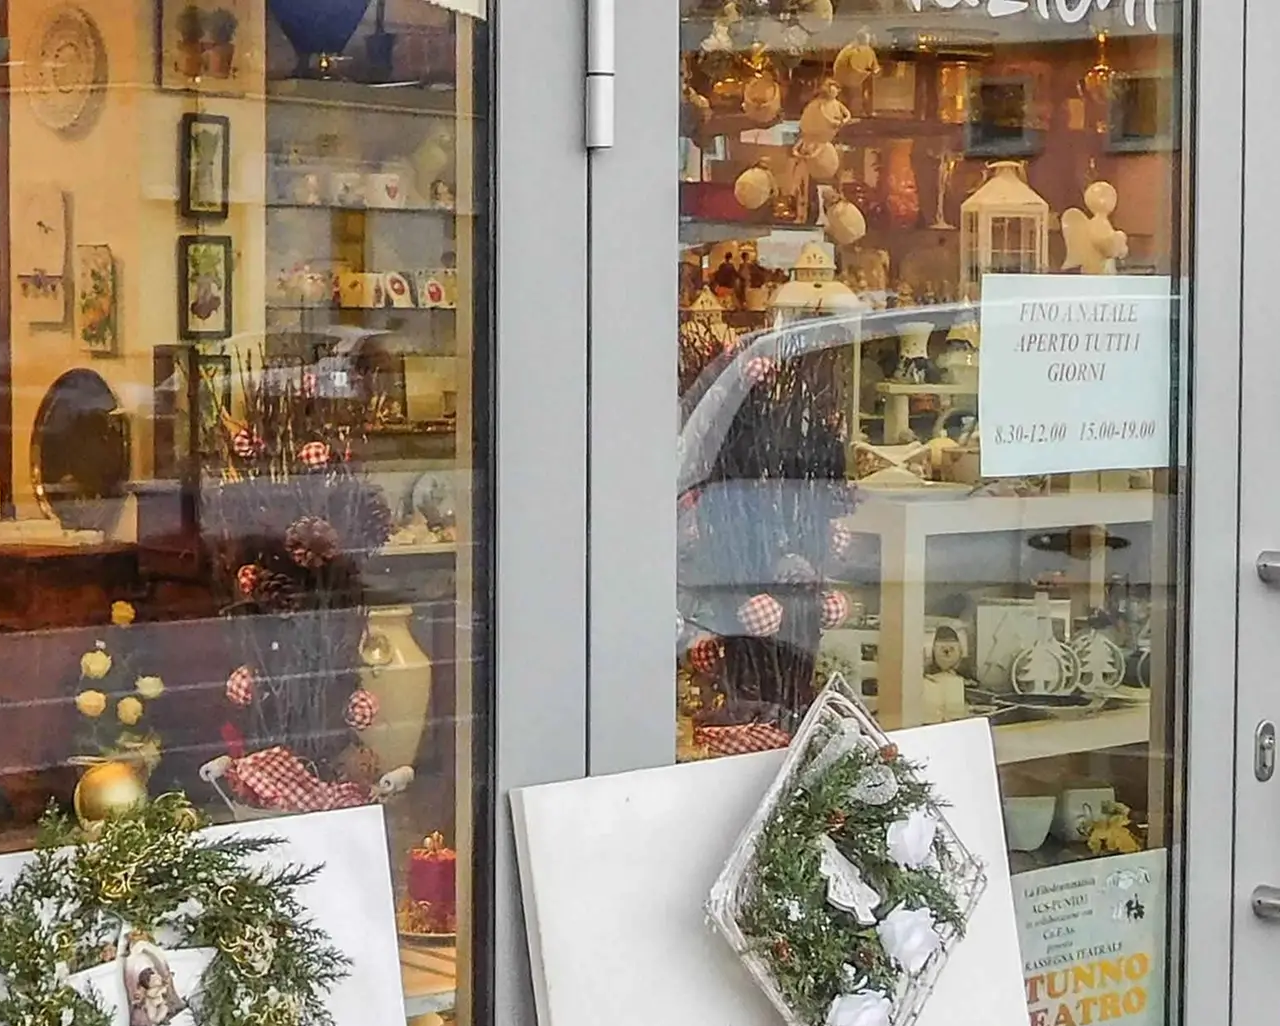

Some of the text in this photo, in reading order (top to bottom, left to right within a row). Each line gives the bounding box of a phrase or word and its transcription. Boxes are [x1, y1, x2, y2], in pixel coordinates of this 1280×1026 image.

[1020, 302, 1140, 323] FINO A NATALE
[1015, 333, 1080, 353] APERTO
[1084, 333, 1134, 352] TUTTI
[1047, 363, 1106, 383] GIORNI
[994, 419, 1157, 445] 8.30-12.00 15.00-19.00
[1024, 953, 1150, 1005] TUNNO
